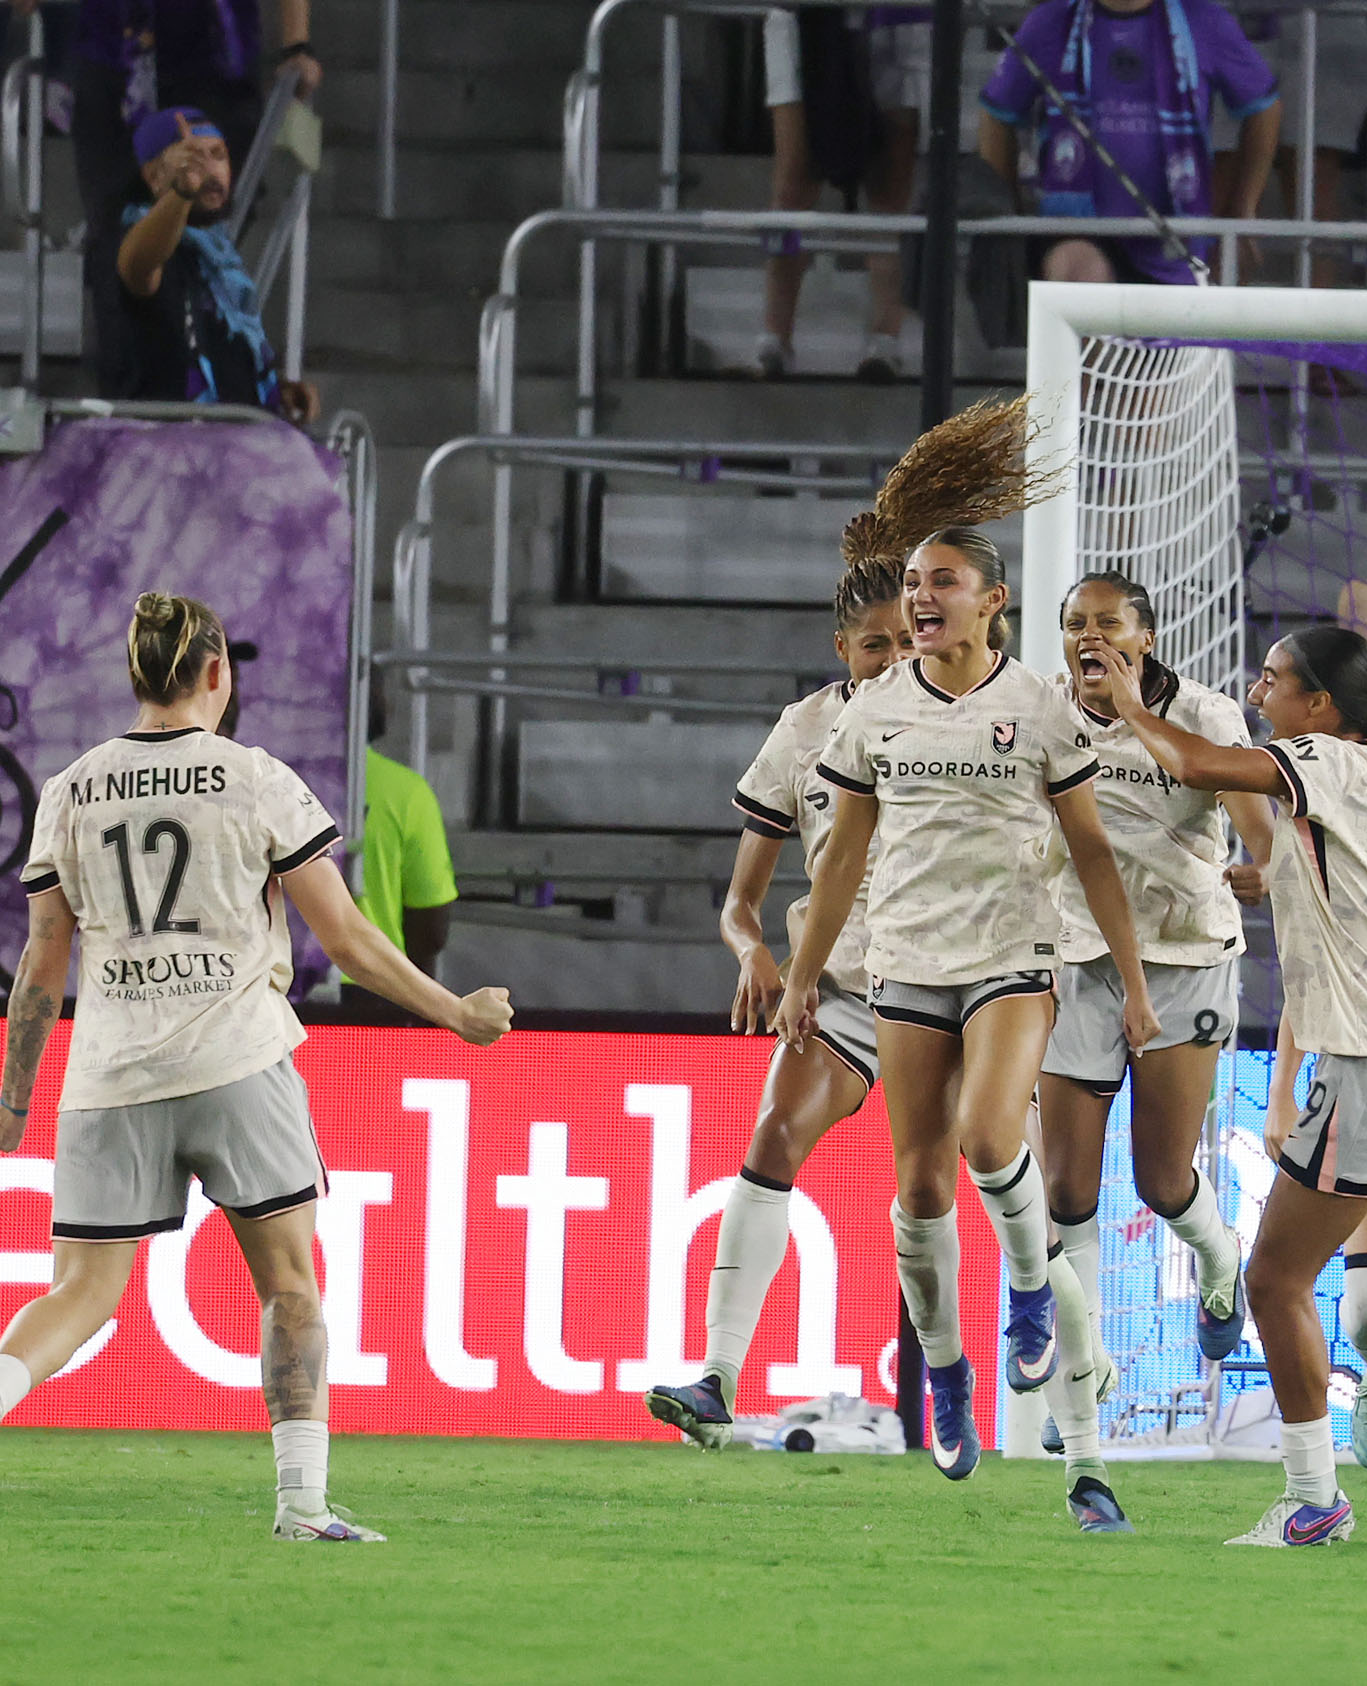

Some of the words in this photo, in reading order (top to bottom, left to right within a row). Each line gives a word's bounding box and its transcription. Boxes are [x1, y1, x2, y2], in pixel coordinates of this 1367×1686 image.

[1289, 735, 1320, 761] lly
[898, 761, 1017, 779] DOORDASH
[71, 777, 100, 807] M.
[106, 765, 227, 801] NIEHUES
[101, 817, 202, 938] 12
[168, 979, 233, 998] MARKET
